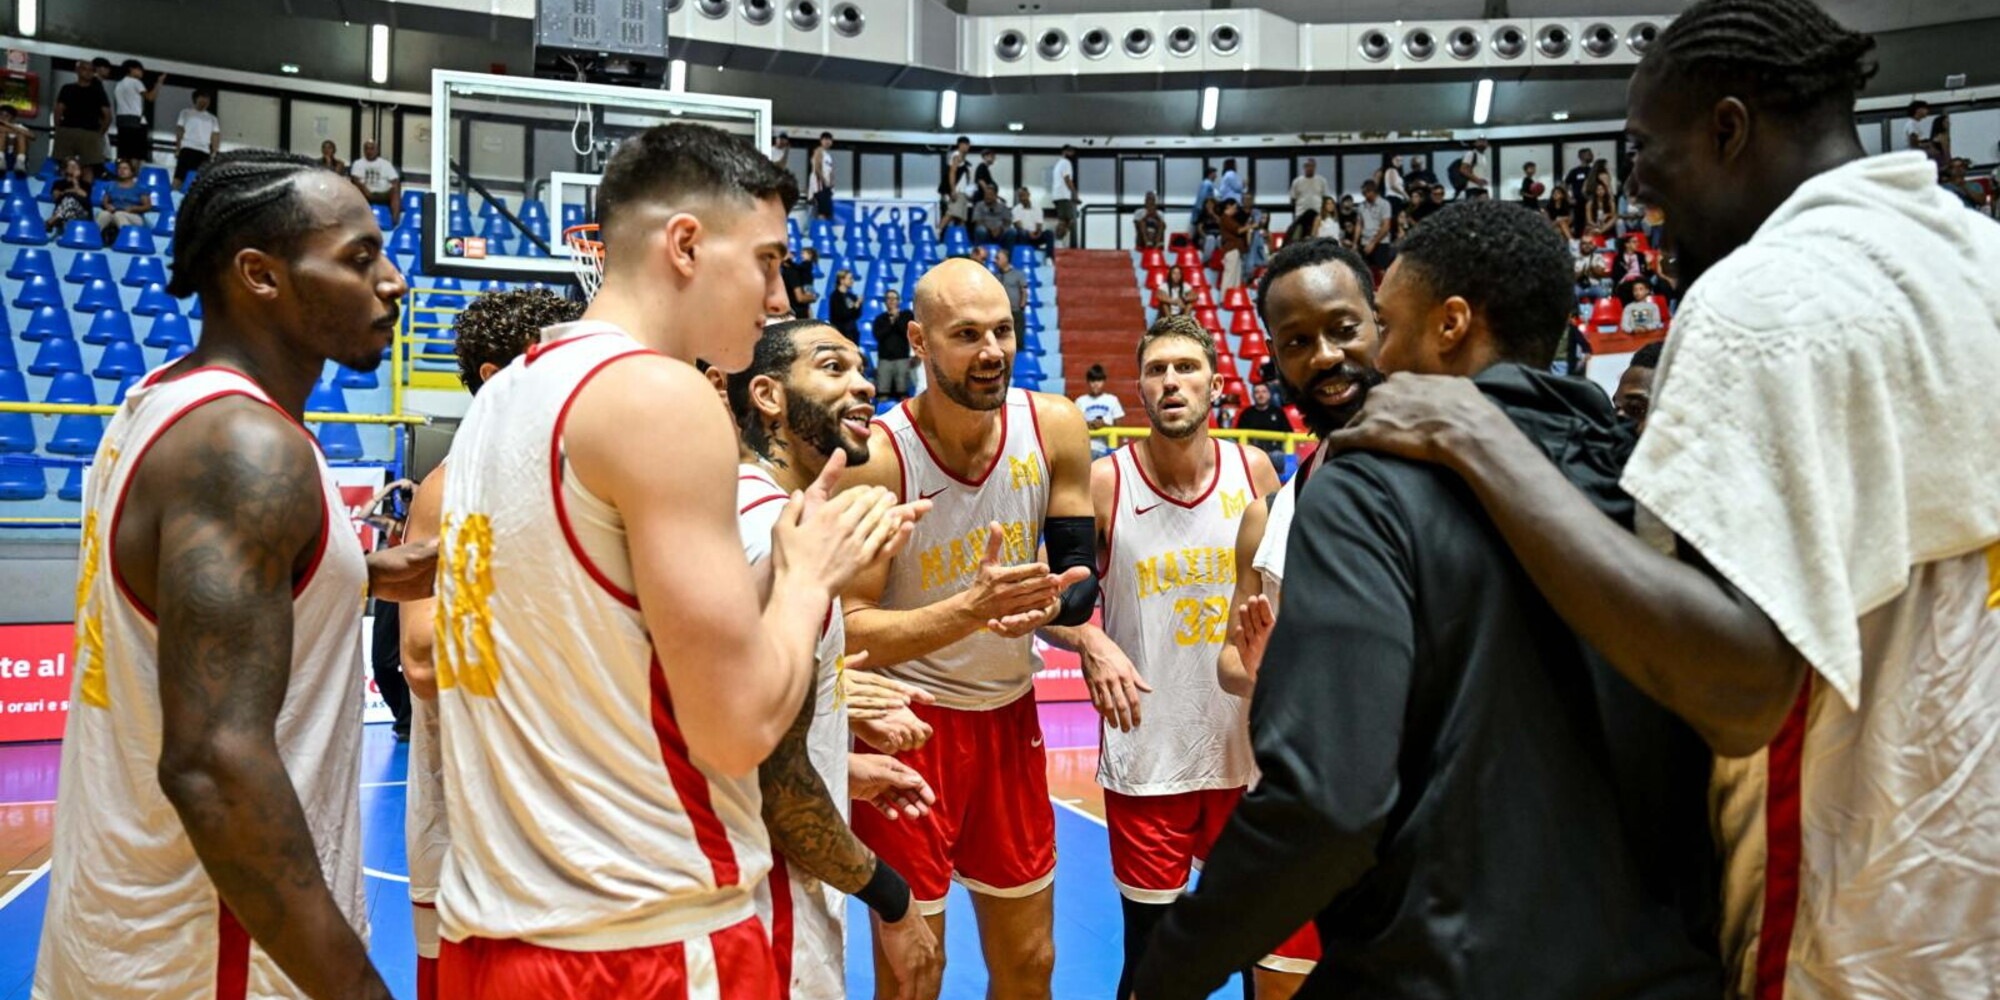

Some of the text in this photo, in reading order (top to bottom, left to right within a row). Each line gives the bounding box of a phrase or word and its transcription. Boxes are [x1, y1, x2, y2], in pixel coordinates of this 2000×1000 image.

[1173, 595, 1229, 647] 32
[37, 652, 66, 677] al
[7, 698, 45, 713] orari
[47, 700, 57, 712] e
